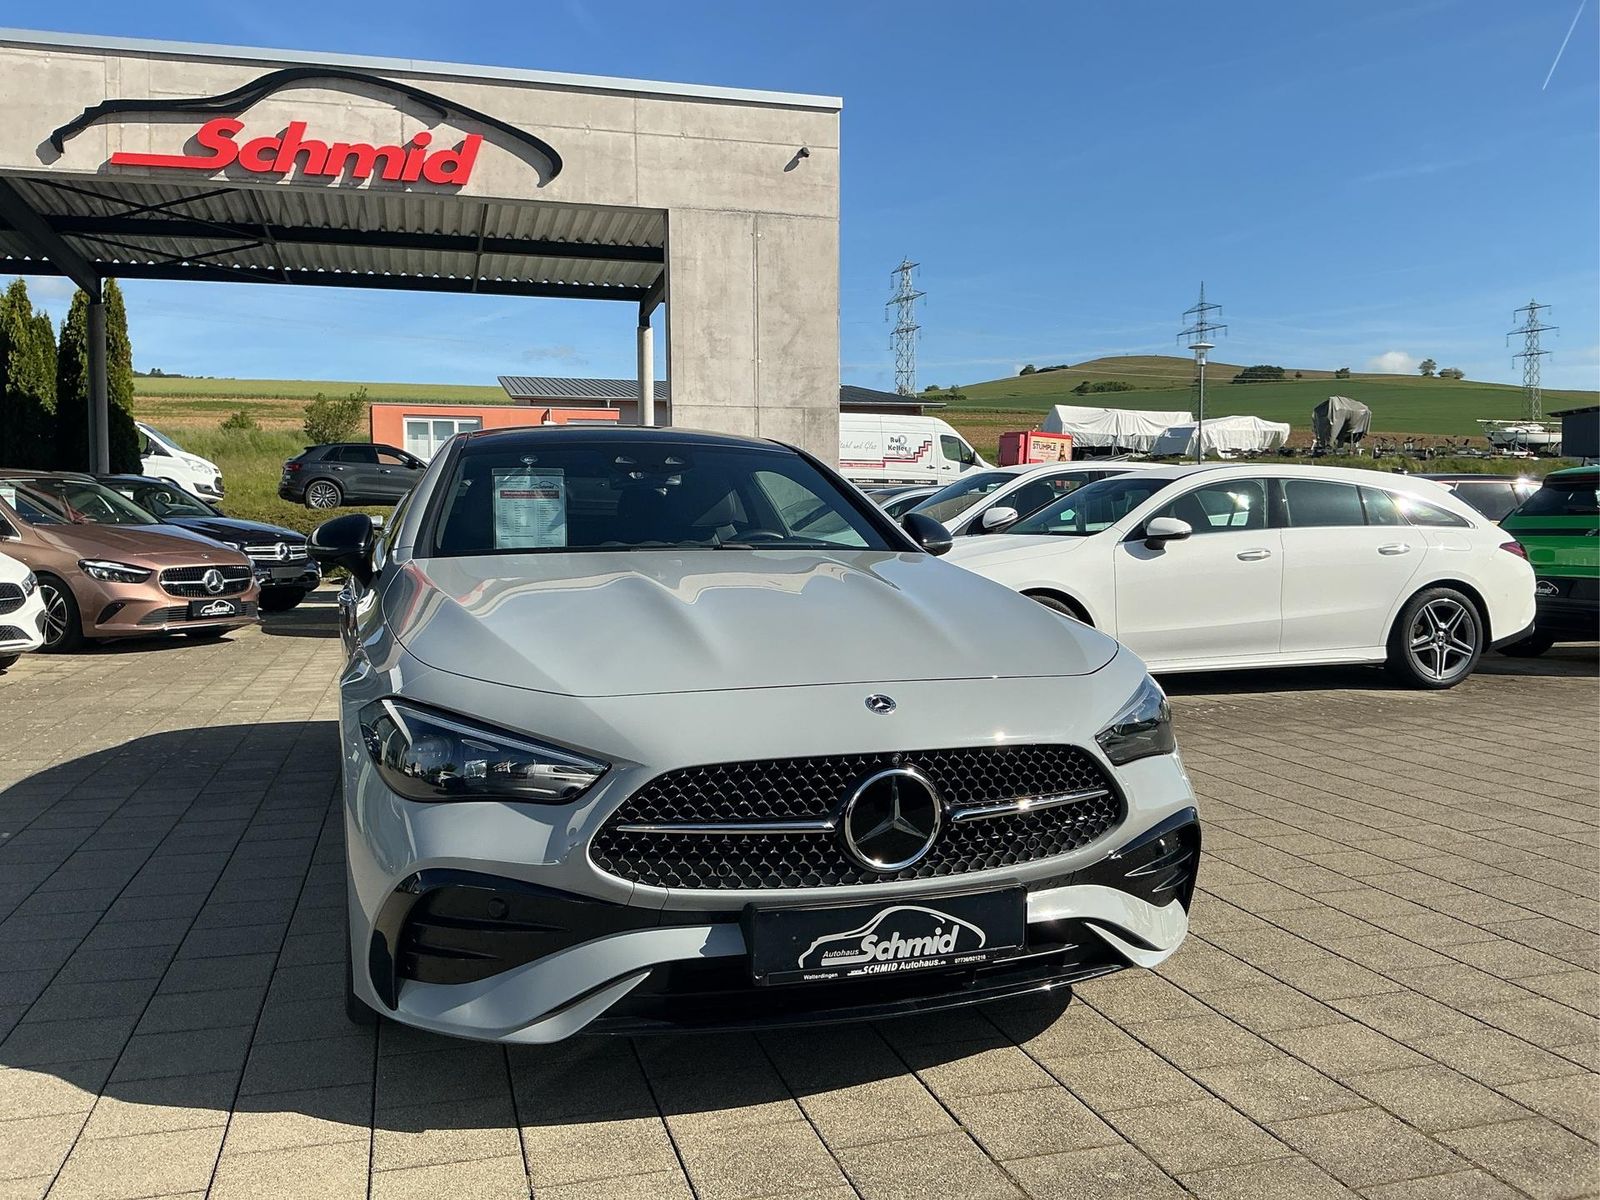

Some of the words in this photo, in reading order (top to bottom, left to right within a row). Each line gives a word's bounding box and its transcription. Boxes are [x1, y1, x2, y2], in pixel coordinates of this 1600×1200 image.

[111, 117, 483, 185] Schmid
[821, 925, 960, 967] Schmid
[822, 949, 860, 959] Autohaus
